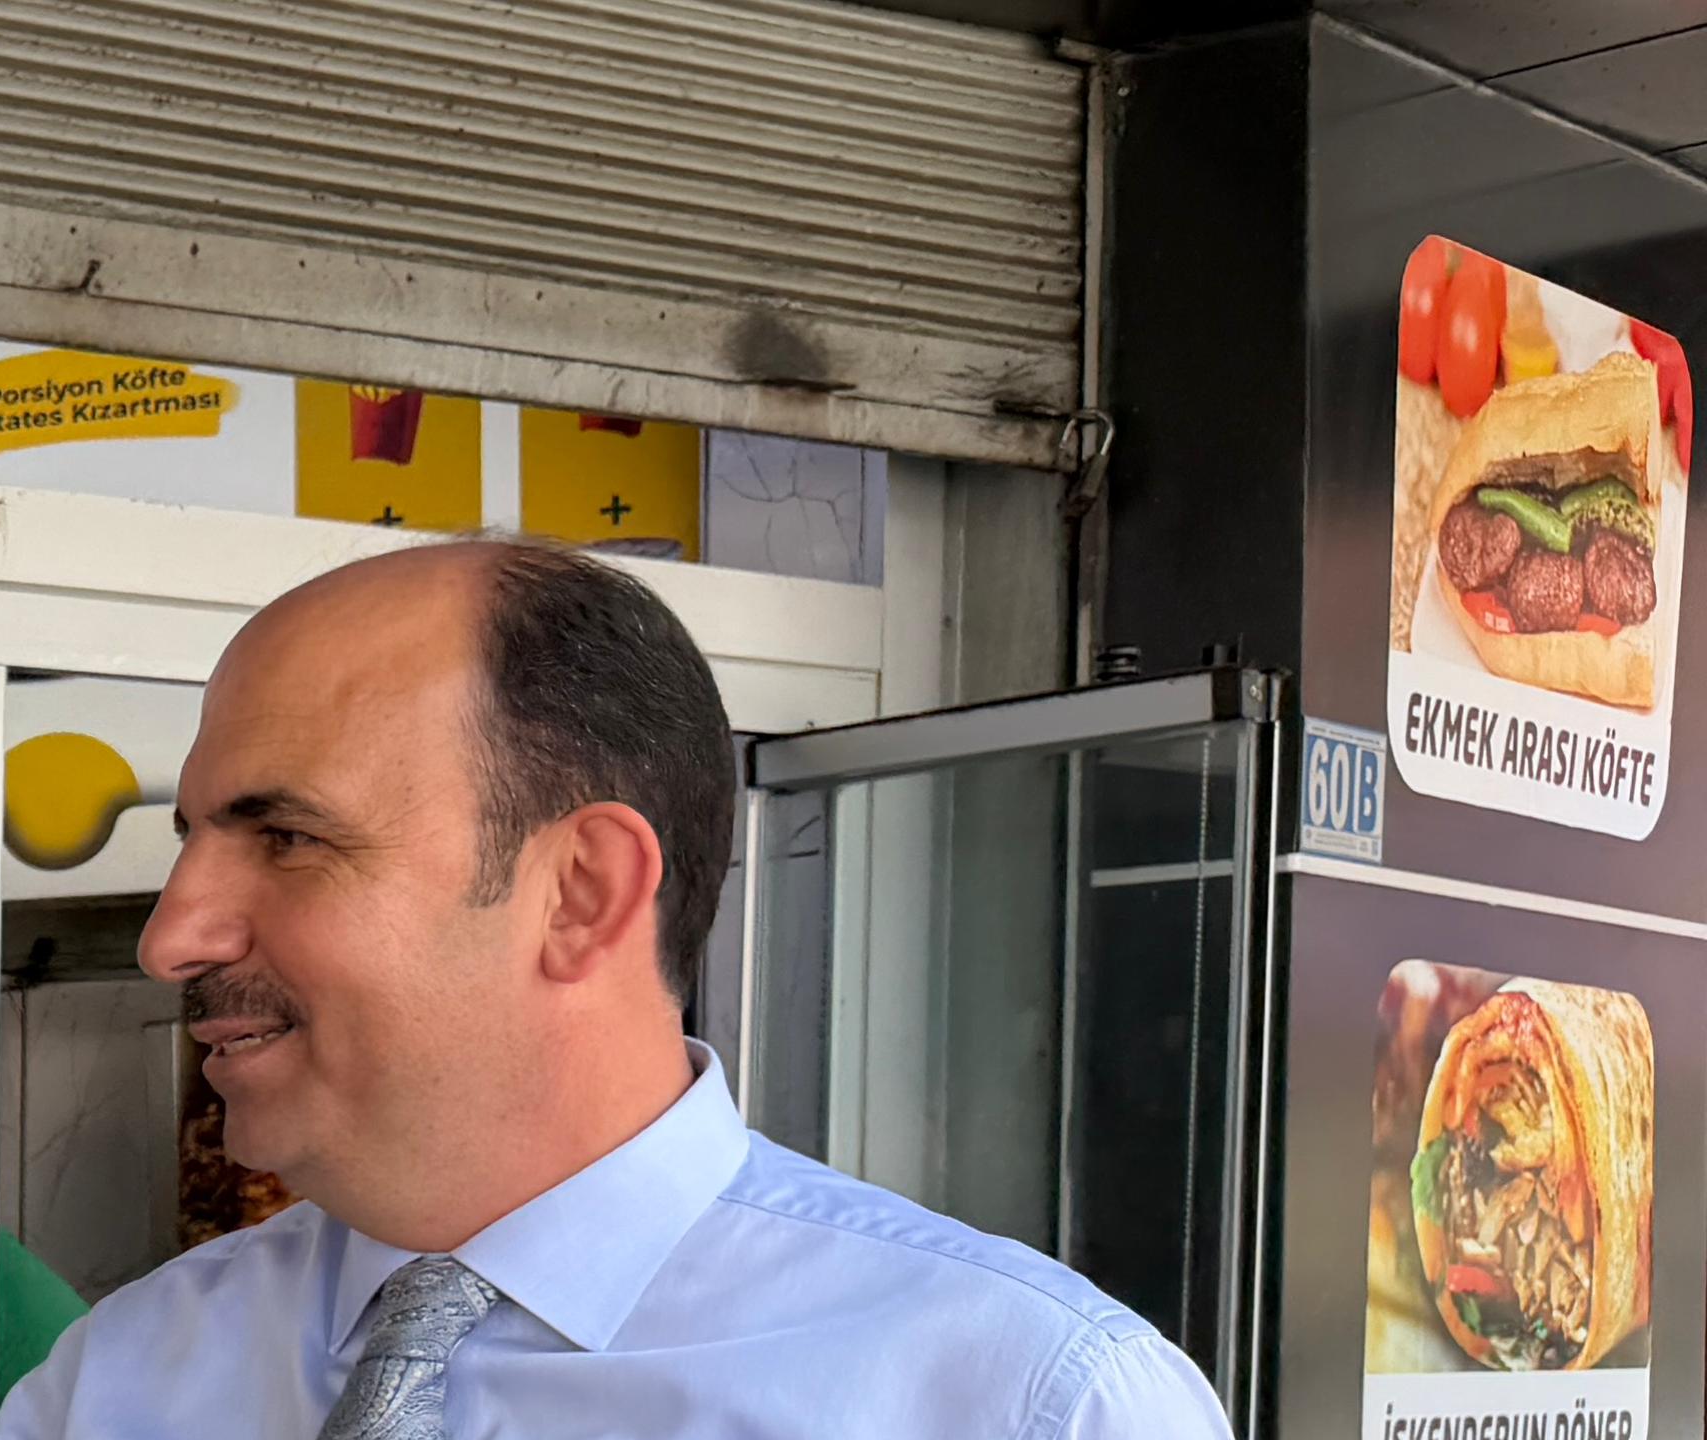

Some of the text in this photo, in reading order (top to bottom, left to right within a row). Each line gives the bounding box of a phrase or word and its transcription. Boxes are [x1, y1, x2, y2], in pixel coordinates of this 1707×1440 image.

[113, 366, 187, 393] Köfte
[72, 390, 222, 424] Kızartması
[1405, 692, 1656, 808] EKMEK ARASI KÖFTE
